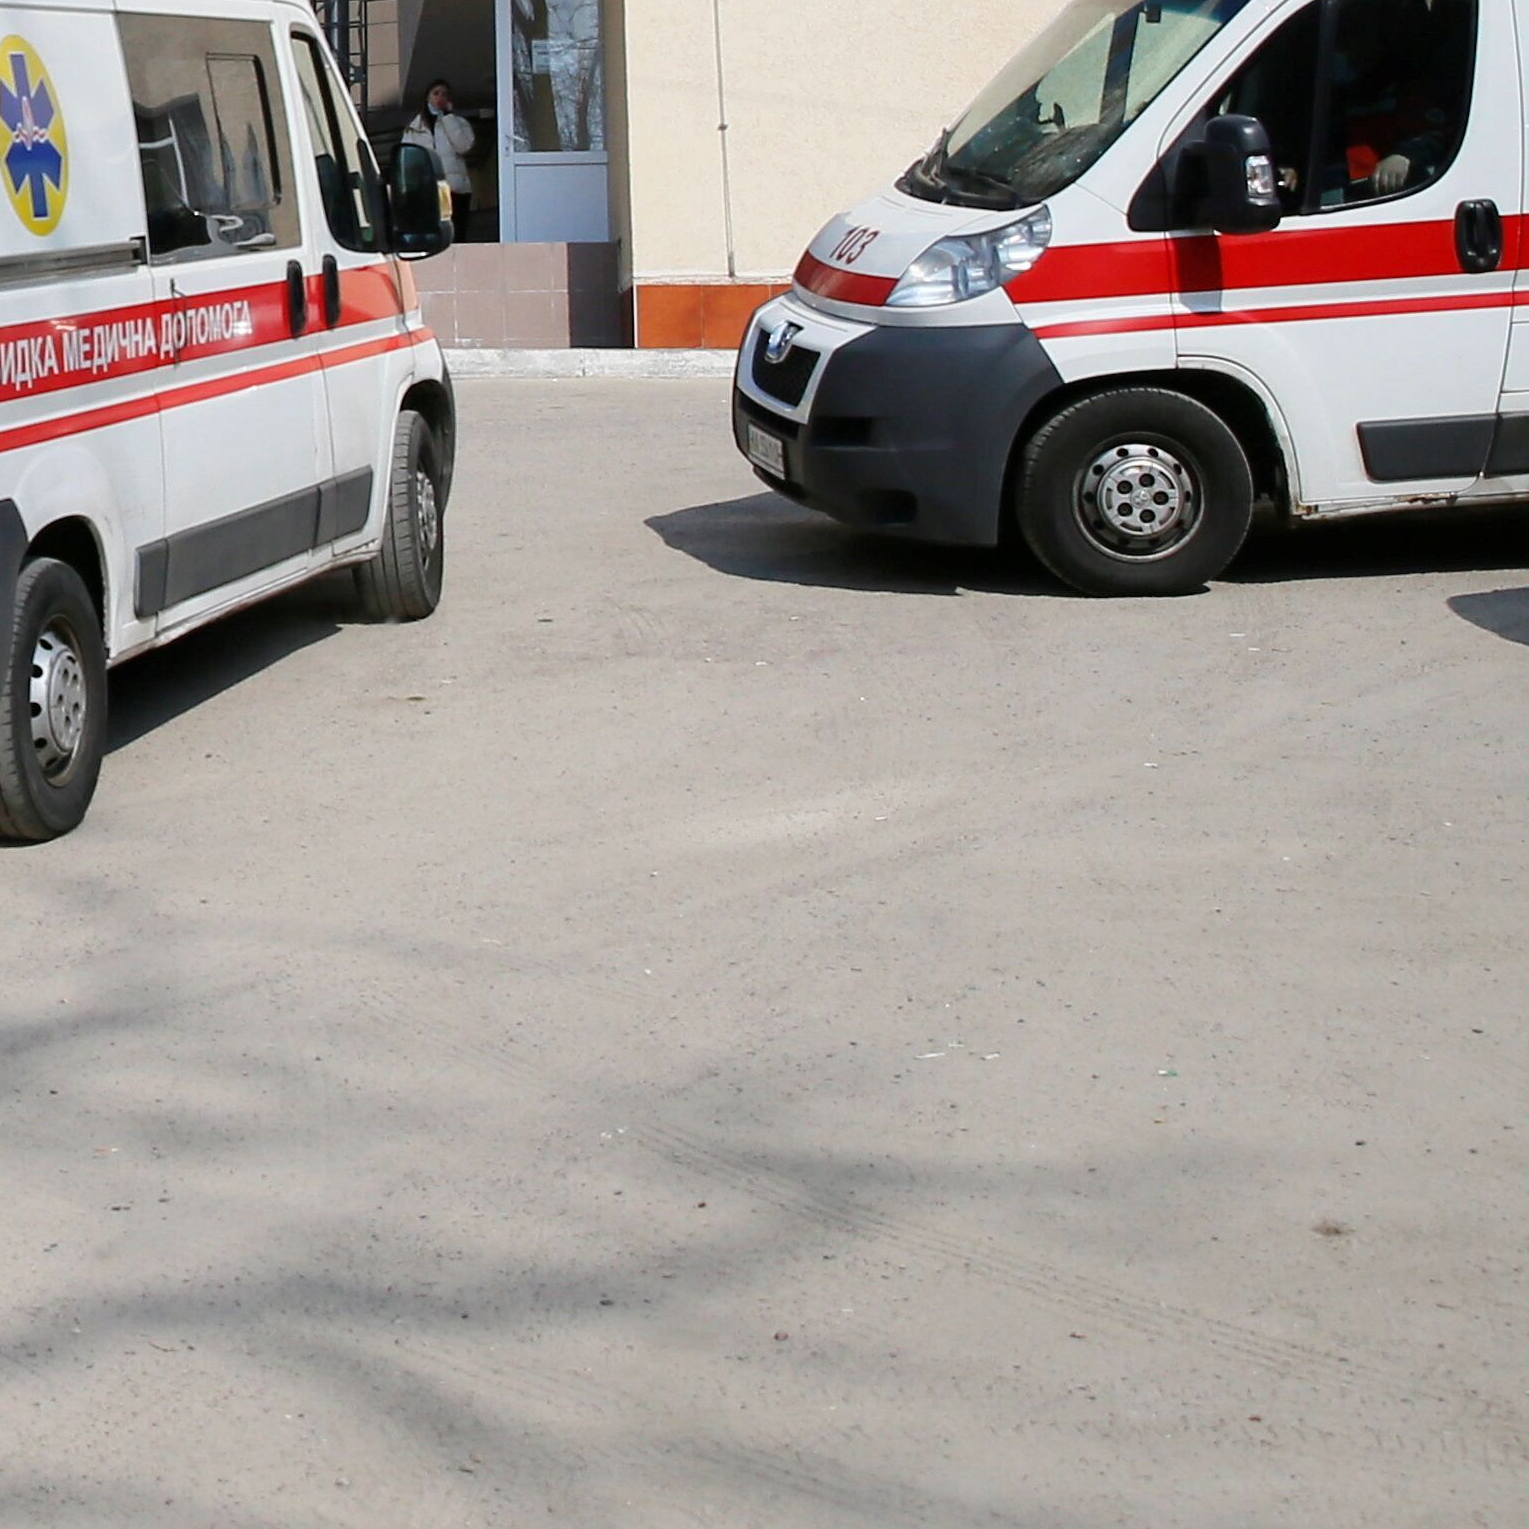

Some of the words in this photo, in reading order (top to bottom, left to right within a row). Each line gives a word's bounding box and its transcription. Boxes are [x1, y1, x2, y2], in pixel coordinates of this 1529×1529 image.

[829, 225, 880, 265] 103
[62, 317, 157, 374] МЕДИЧНА
[160, 300, 253, 359] ДОПОМОГА
